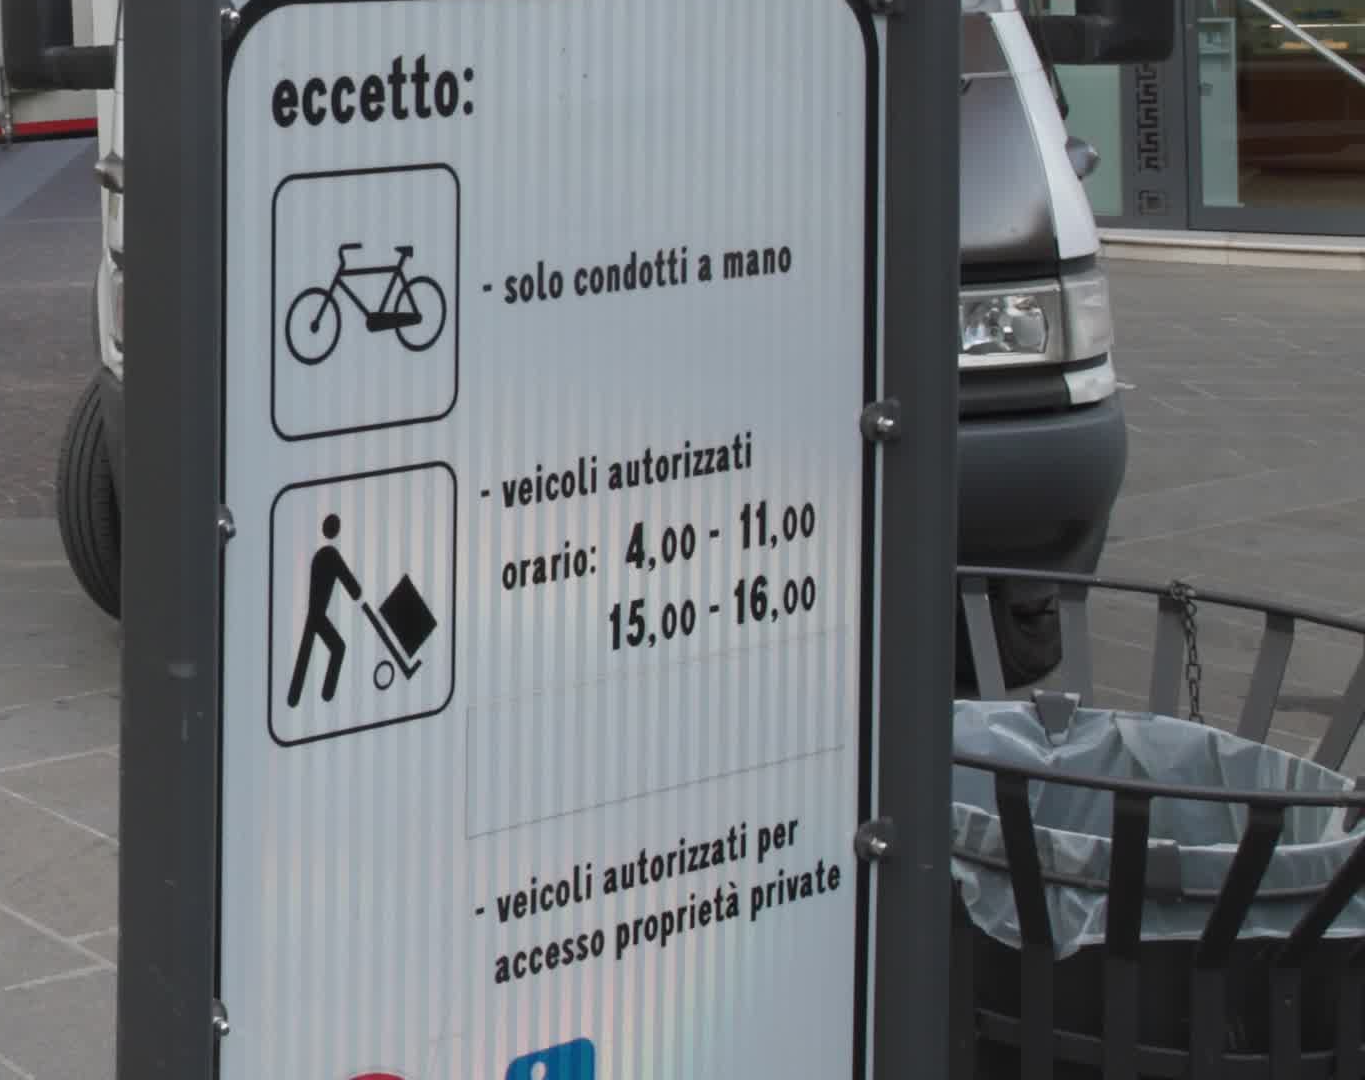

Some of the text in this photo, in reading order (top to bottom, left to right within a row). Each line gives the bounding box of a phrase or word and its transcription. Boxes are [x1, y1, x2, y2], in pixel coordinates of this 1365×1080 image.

[272, 54, 474, 128] eccetto:
[504, 261, 563, 304] solo
[574, 245, 687, 297] condotti
[698, 255, 712, 282] a
[723, 245, 792, 280] mano
[502, 456, 597, 508] veicoli
[608, 432, 752, 491] autorizzati
[502, 542, 597, 590] orario:
[626, 521, 696, 571] 4,00
[739, 500, 816, 549] 11,00
[609, 598, 696, 650] 15,00
[734, 575, 816, 624] 16,00
[497, 864, 592, 922] veicoli
[603, 821, 747, 896] autorizzati
[757, 818, 799, 861] per
[495, 858, 841, 984] accesso proprietà private
